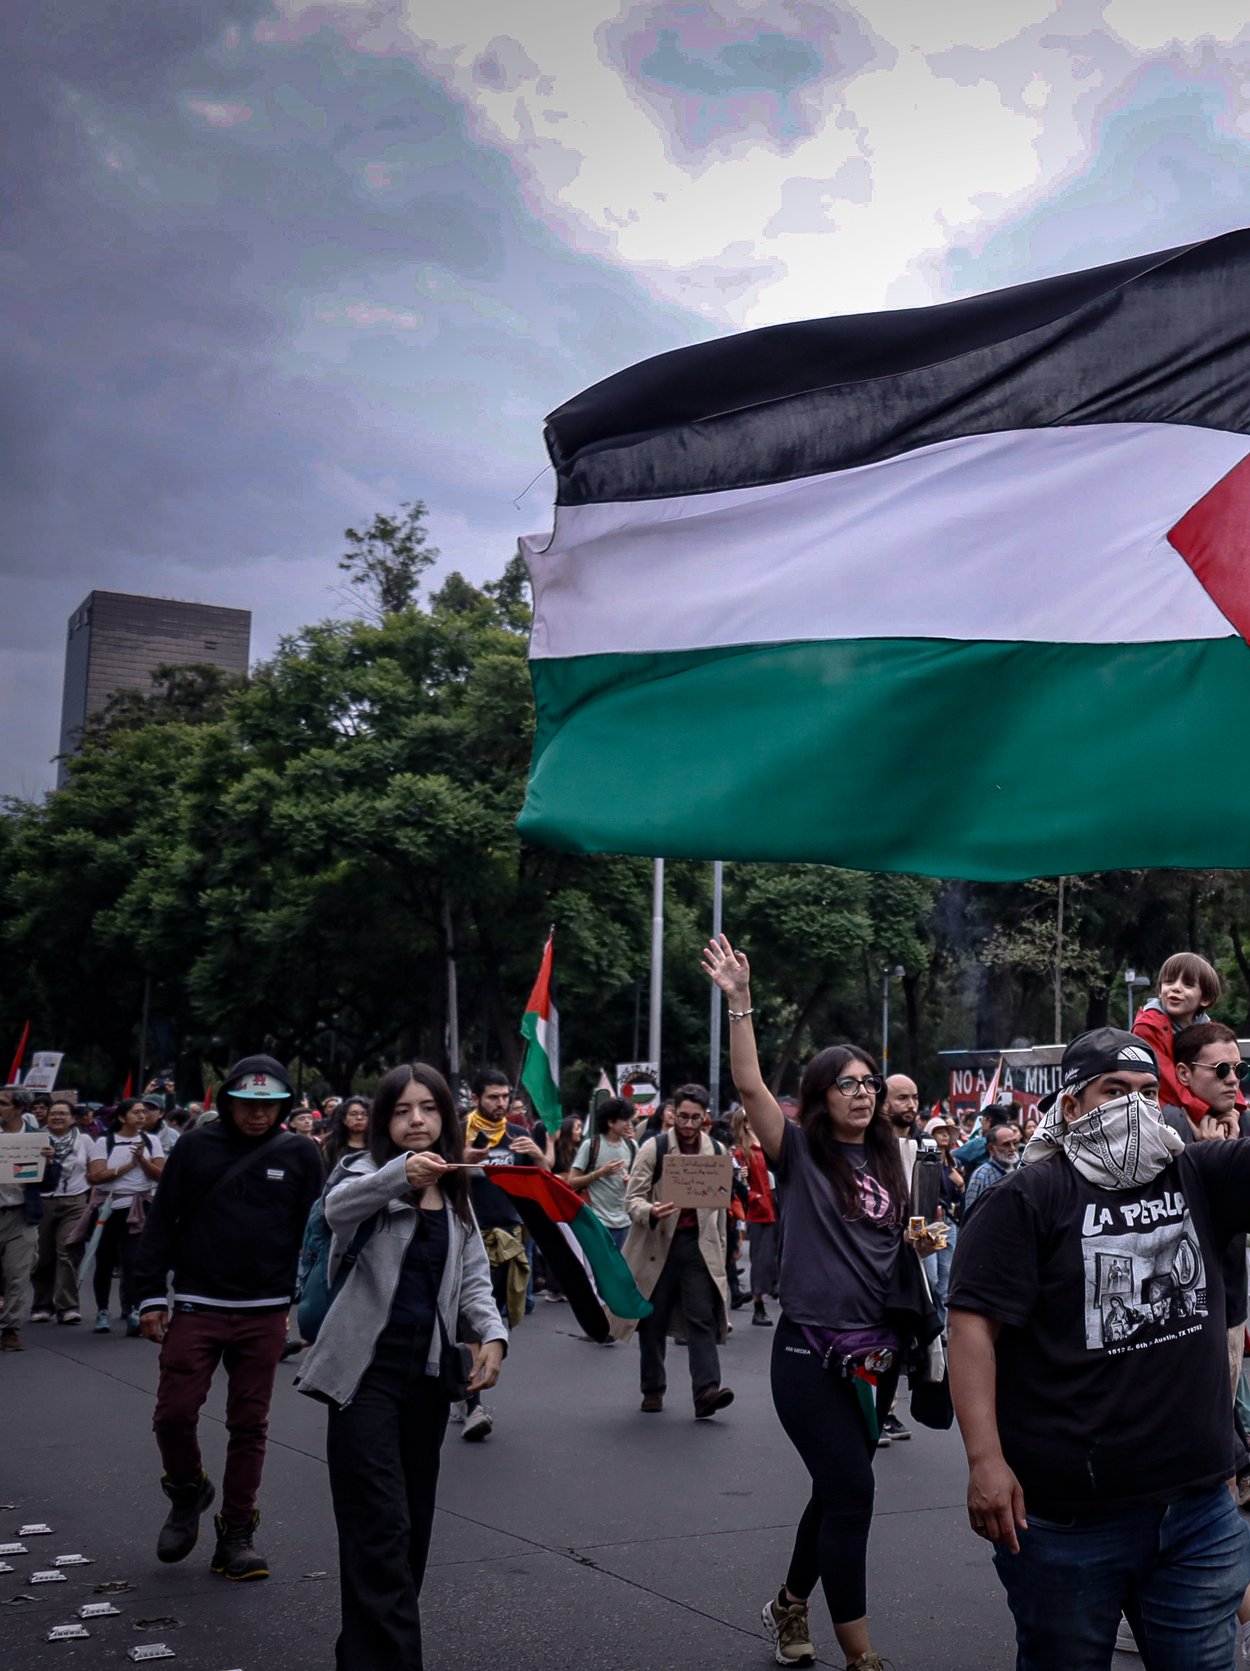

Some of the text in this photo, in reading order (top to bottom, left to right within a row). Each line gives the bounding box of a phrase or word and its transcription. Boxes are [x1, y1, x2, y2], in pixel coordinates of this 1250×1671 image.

[952, 1070, 973, 1096] NO
[1082, 1191, 1186, 1236] LA PERLA
[1135, 1342, 1148, 1350] 6th
[1153, 1334, 1178, 1345] Austin,
[1178, 1329, 1187, 1338] TX
